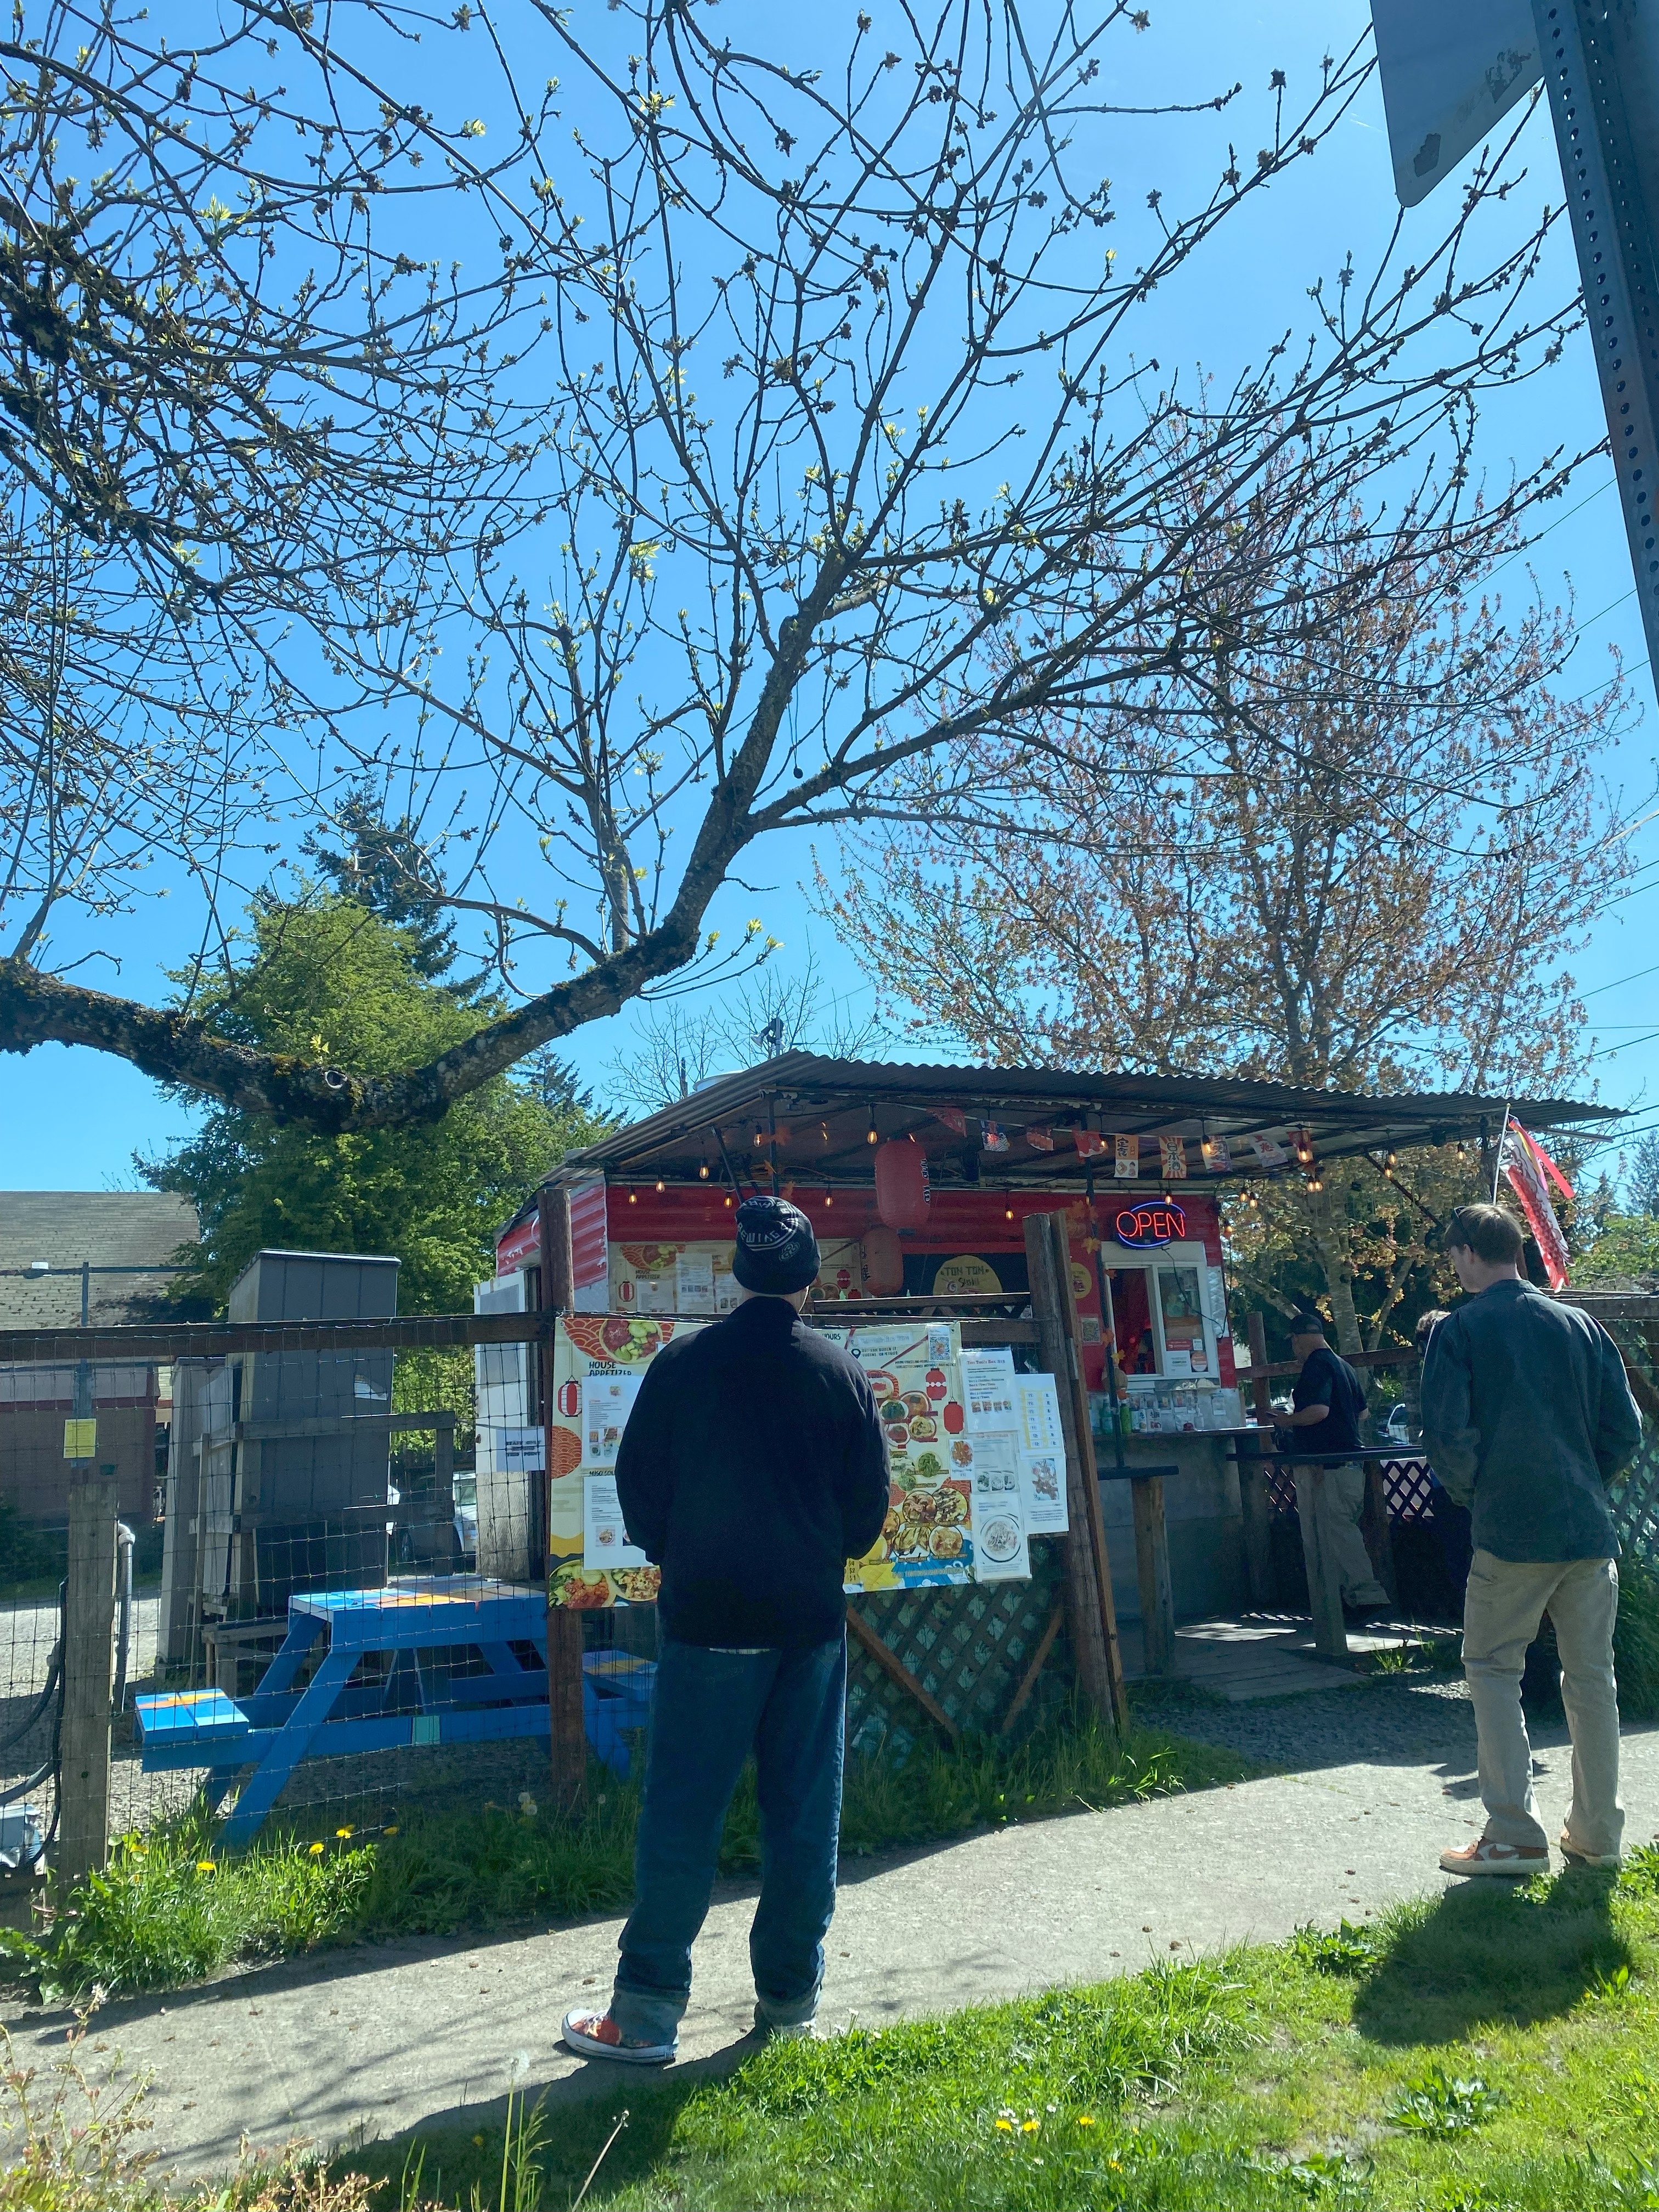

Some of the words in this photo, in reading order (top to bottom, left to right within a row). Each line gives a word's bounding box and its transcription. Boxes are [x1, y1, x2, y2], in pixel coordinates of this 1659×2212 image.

[1166, 1142, 1181, 1171] 日本酒
[1116, 1211, 1185, 1237] OPEN
